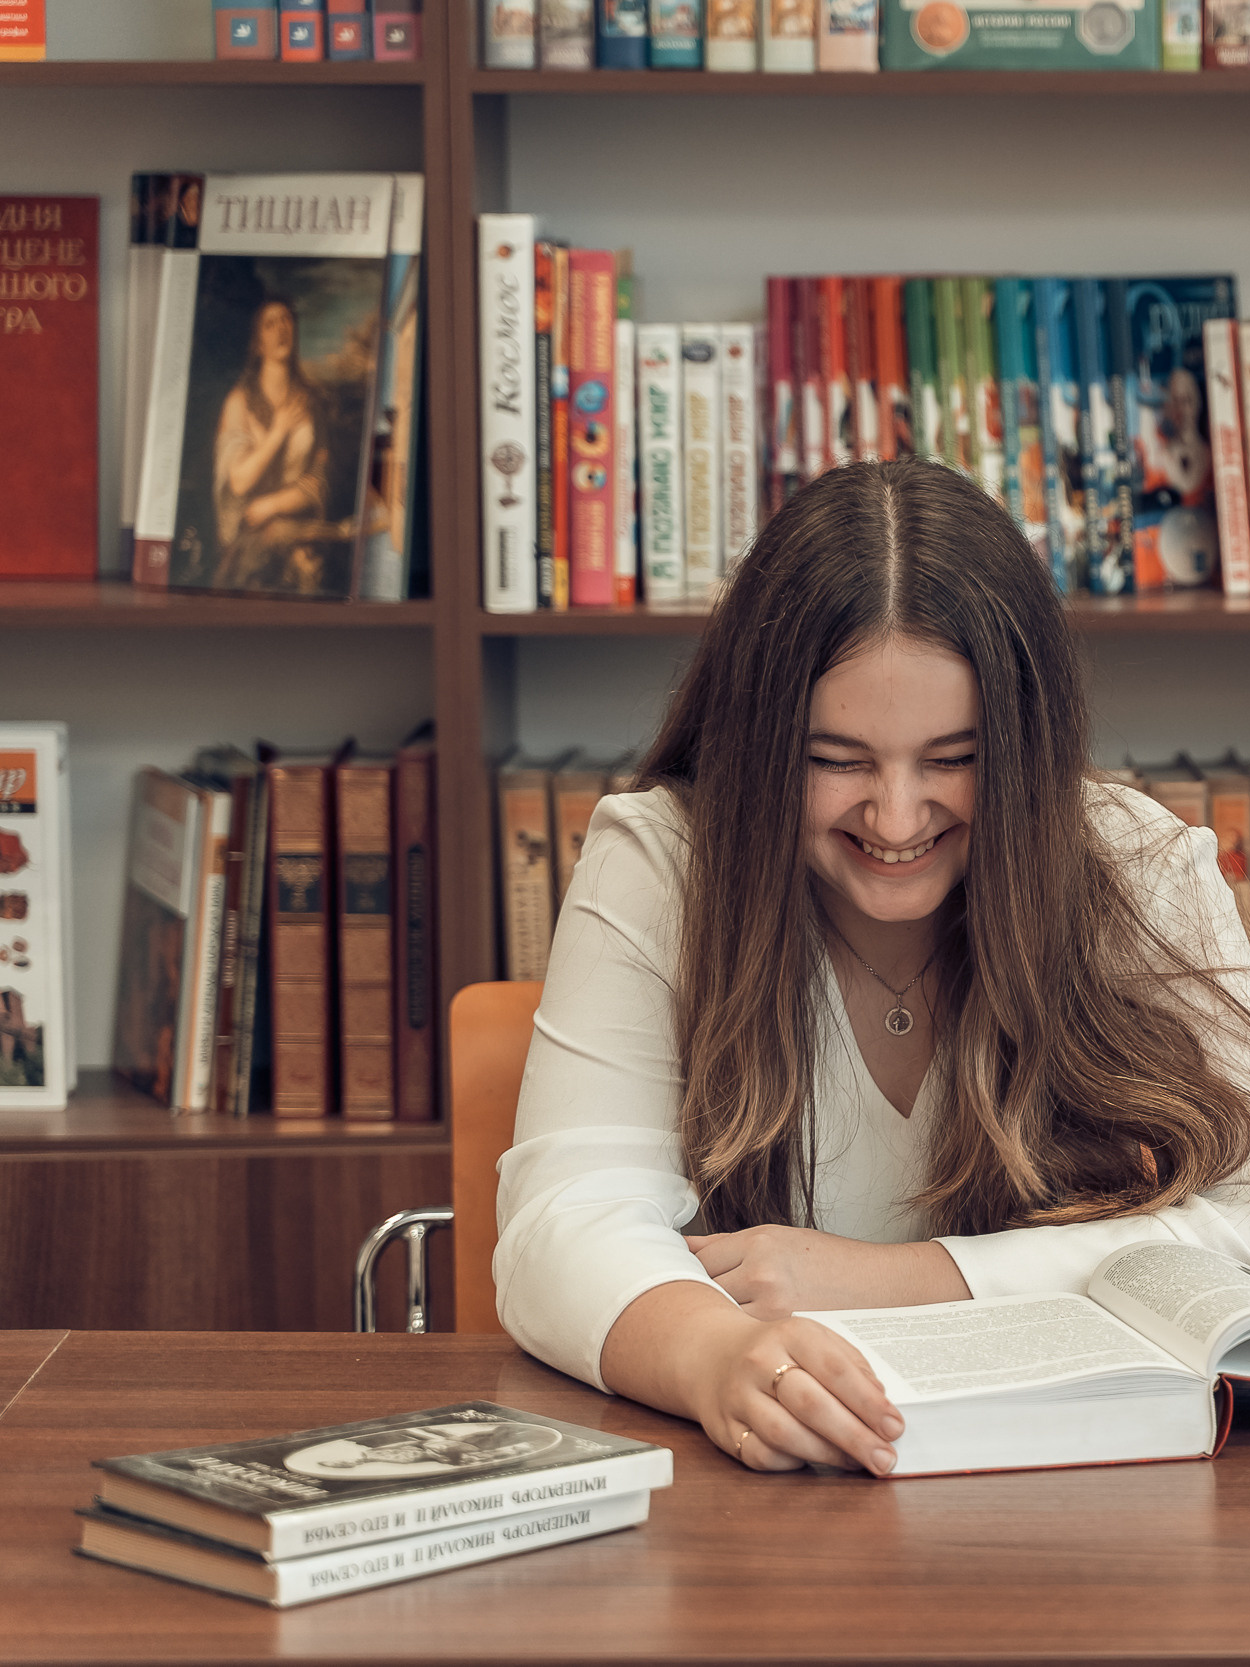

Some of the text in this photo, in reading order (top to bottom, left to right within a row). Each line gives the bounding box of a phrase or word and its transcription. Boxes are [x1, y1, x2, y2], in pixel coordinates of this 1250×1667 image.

[217, 194, 371, 235] ТИЦИАН
[494, 273, 521, 416] Космос
[651, 448, 673, 554] ПОЗНАЮ
[511, 1476, 607, 1505] ИМПЕРАТОРЪ
[394, 1511, 406, 1527] И
[430, 1493, 504, 1521] НИКОЛАЙ
[303, 1519, 357, 1543] СЕМЬЯ
[362, 1515, 389, 1533] ЕГО
[503, 1509, 591, 1540] ИМПЕРАТОРЪ
[393, 1551, 405, 1567] И
[427, 1531, 495, 1560] НИКОЛАЙ
[310, 1563, 360, 1587] СЕМЬЯ
[363, 1556, 389, 1574] ЕГО
